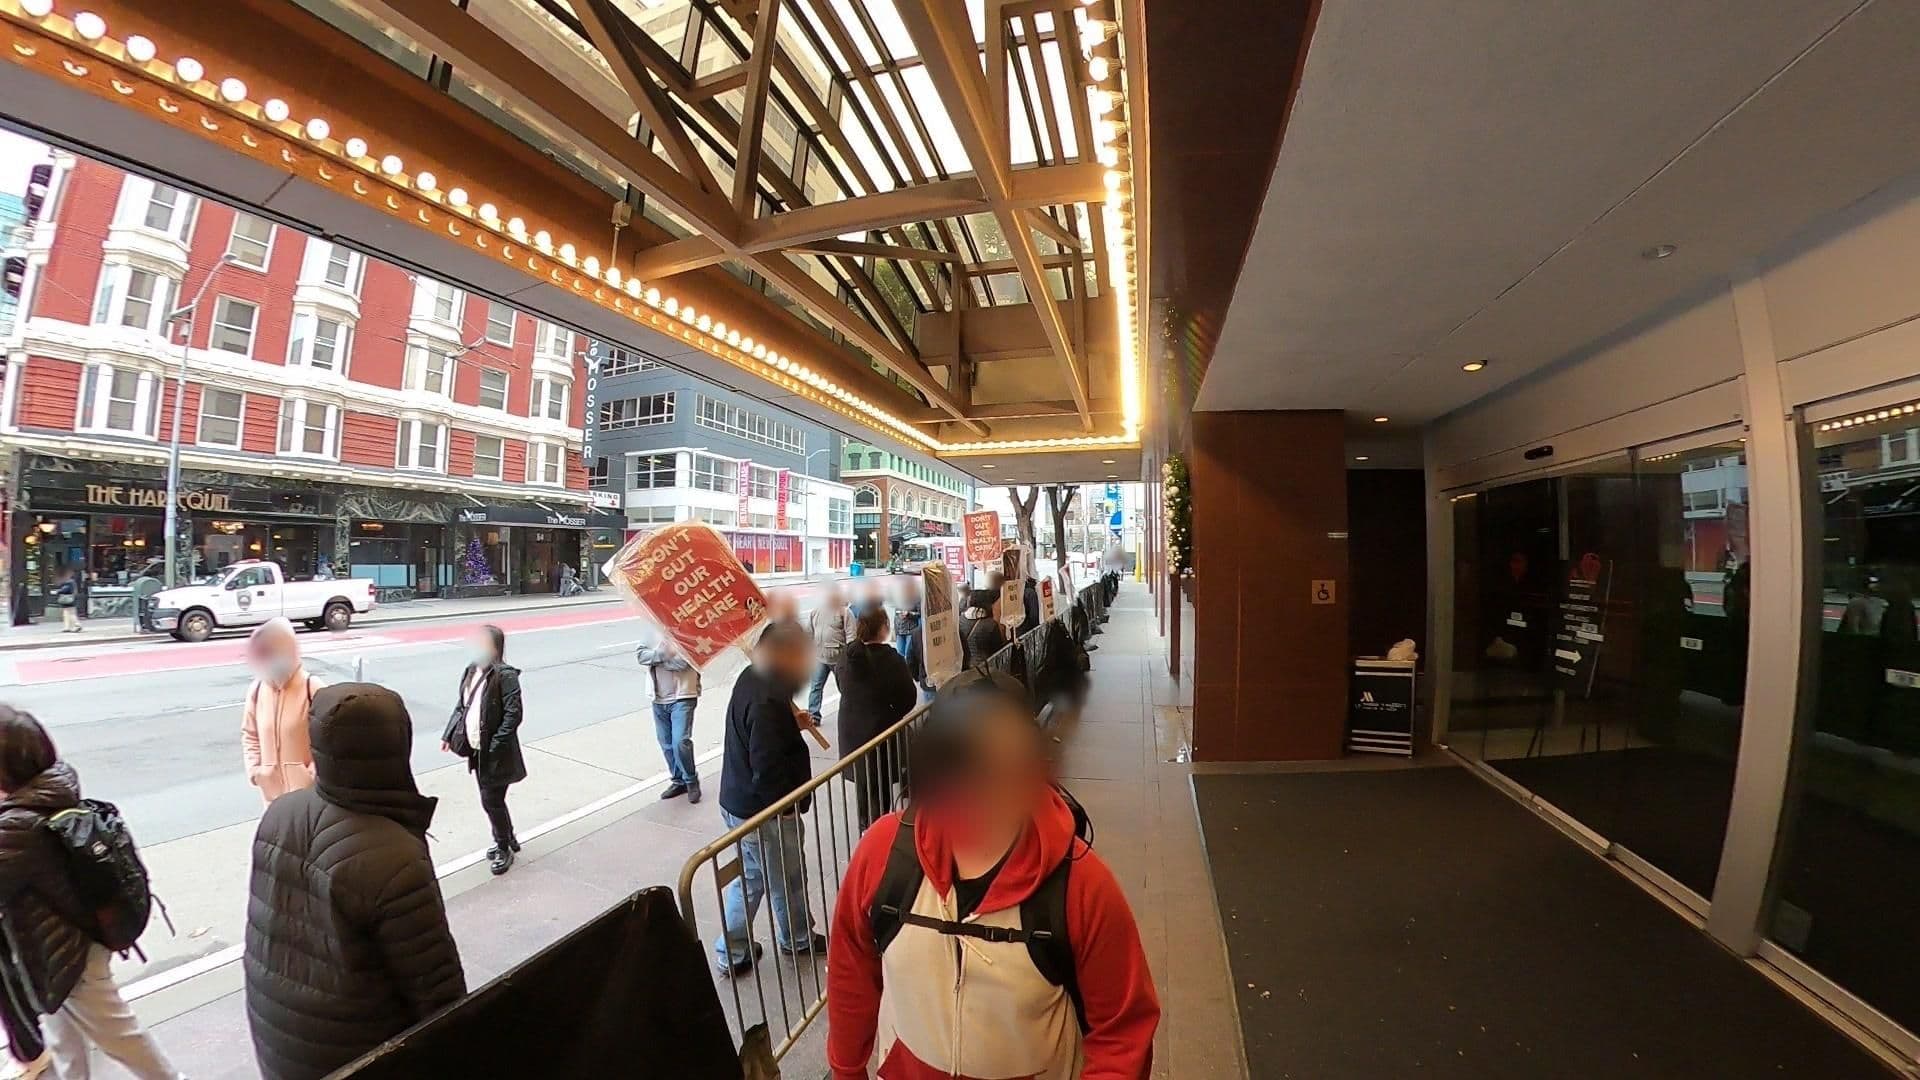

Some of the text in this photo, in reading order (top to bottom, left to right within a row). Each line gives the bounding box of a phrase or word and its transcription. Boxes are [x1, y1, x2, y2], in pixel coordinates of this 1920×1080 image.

[583, 355, 601, 459] MOSSER
[85, 485, 229, 511] THE HAREQUIN
[592, 491, 618, 500] RKING
[546, 512, 586, 526] The MOSSER
[641, 528, 691, 573] DON'T
[661, 549, 696, 581] GUT
[671, 570, 736, 623] HEALTH
[674, 565, 711, 596] OUR
[694, 593, 739, 629] CARE
